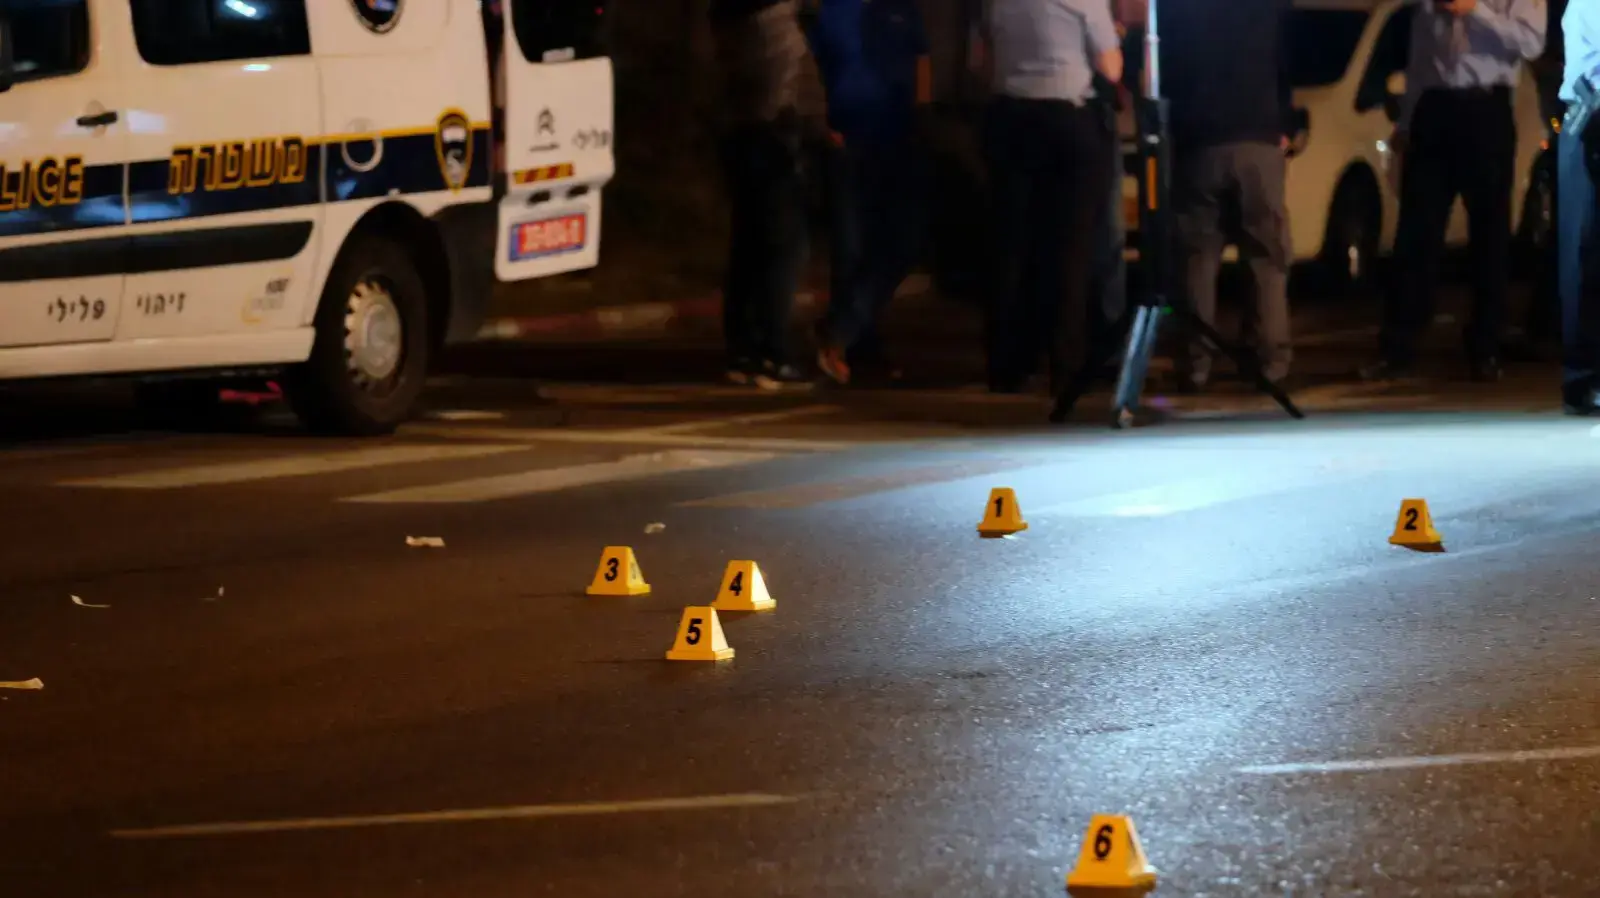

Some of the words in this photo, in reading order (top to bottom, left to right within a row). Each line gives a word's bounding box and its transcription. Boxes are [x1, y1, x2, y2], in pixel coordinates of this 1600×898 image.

[168, 134, 306, 195] משטרה
[0, 153, 83, 211] LICE
[47, 294, 106, 323] פלילי
[136, 291, 187, 315] זיהוי
[993, 496, 1004, 518] 1
[1403, 508, 1418, 530] 2
[604, 557, 619, 582] 3
[728, 571, 743, 596] 4
[685, 618, 702, 645] 5
[1094, 824, 1113, 859] 6
